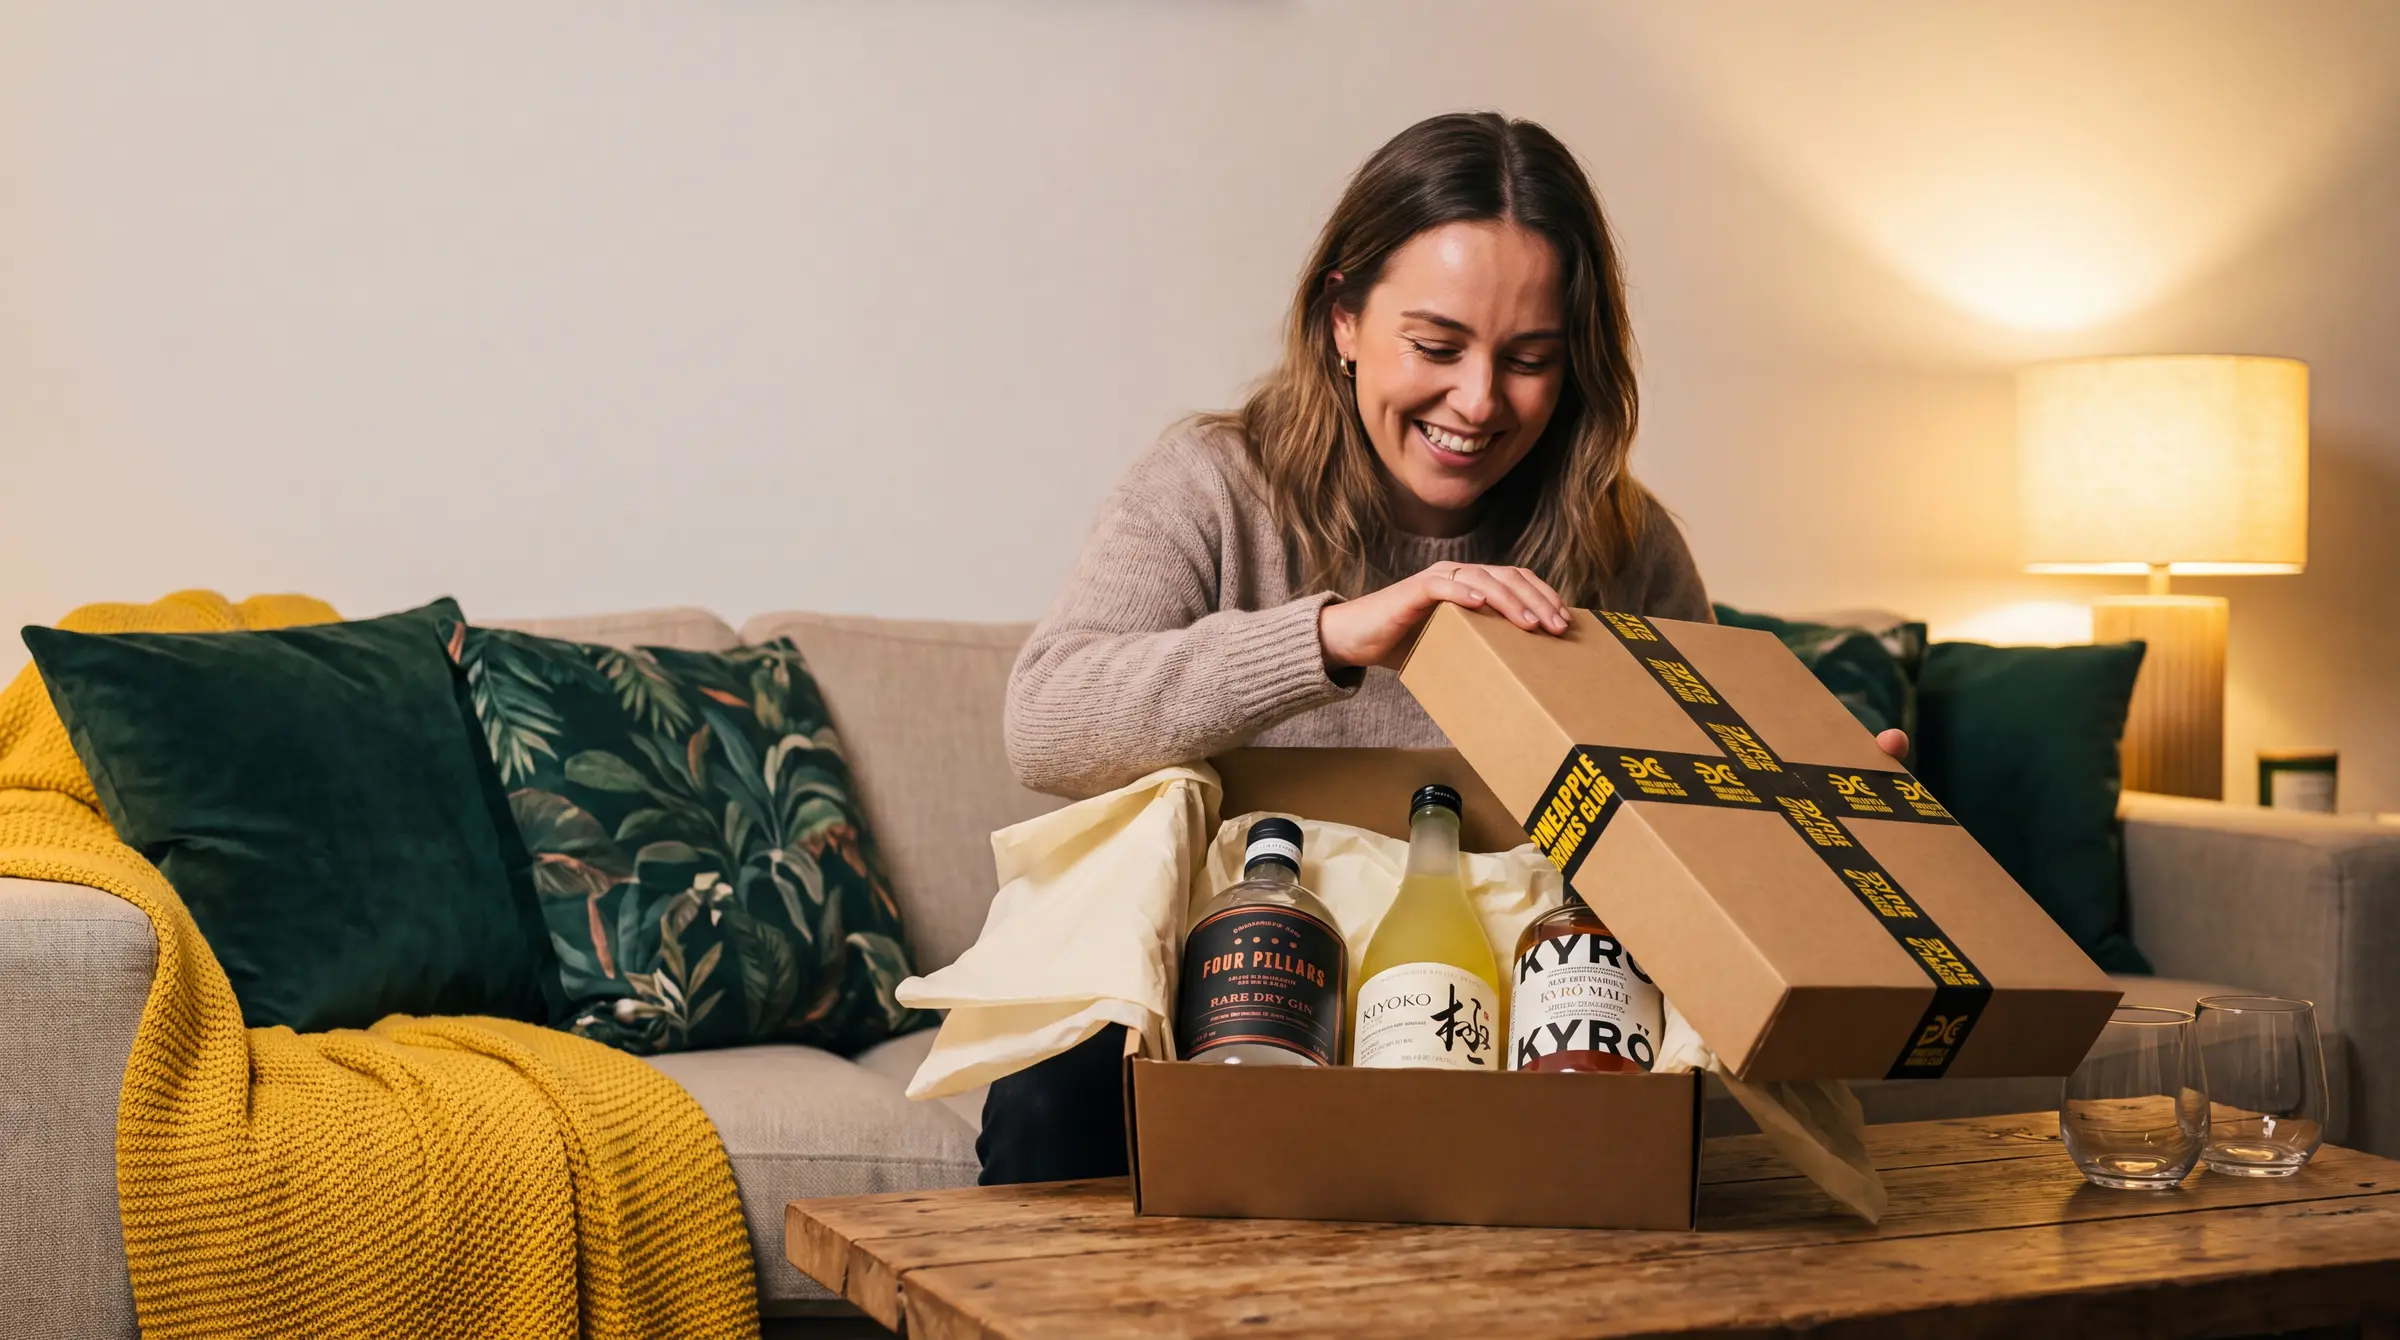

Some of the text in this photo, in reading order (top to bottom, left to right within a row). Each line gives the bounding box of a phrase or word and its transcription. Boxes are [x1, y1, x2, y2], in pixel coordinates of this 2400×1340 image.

[1579, 775, 1615, 823] CLUB
[1202, 951, 1245, 979] FOUR
[1252, 950, 1325, 988] PILLARS
[1210, 992, 1313, 1015] RARE DRY GIN
[1362, 993, 1432, 1023] KIYOKO
[1588, 985, 1632, 1006] MALT
[1517, 1019, 1655, 1072] KYRÖ
